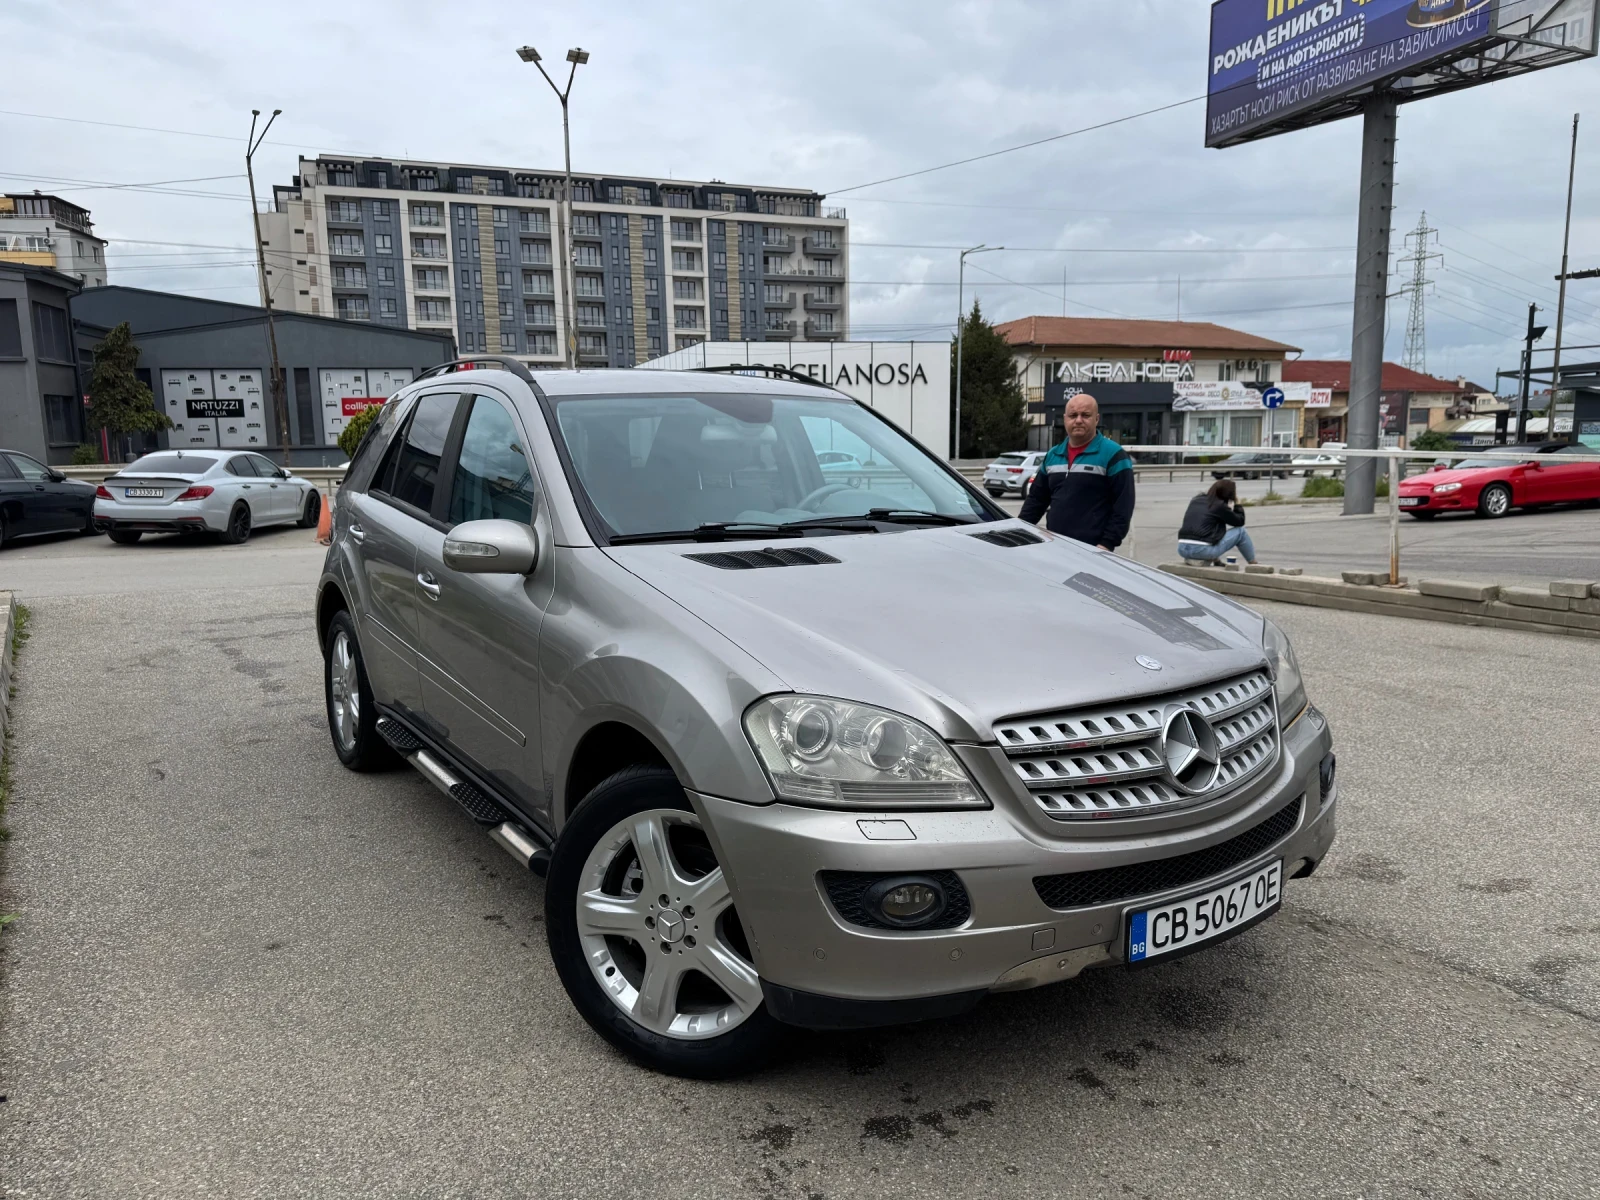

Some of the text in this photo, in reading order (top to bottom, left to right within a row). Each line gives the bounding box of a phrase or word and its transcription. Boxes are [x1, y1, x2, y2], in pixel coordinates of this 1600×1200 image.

[1213, 0, 1343, 75] РОЖДЕНИКЪТ
[1262, 23, 1359, 79] И НА АФТЪРПАРТИ
[1211, 104, 1250, 135] ХАЗАРТЪТ
[1251, 93, 1275, 117] НОСИ
[1277, 84, 1300, 108] РИСК
[1302, 76, 1315, 99] ОТ
[1316, 50, 1378, 93] РАЗВИВАНЕ
[1379, 43, 1395, 68] НА
[1397, 8, 1480, 60] ЗАВИСИМОСТ
[1057, 361, 1194, 378] АКВАНОВА
[192, 401, 239, 410] NATUZZI
[1152, 866, 1278, 949] CB 5067 OE
[1132, 941, 1145, 955] BG
